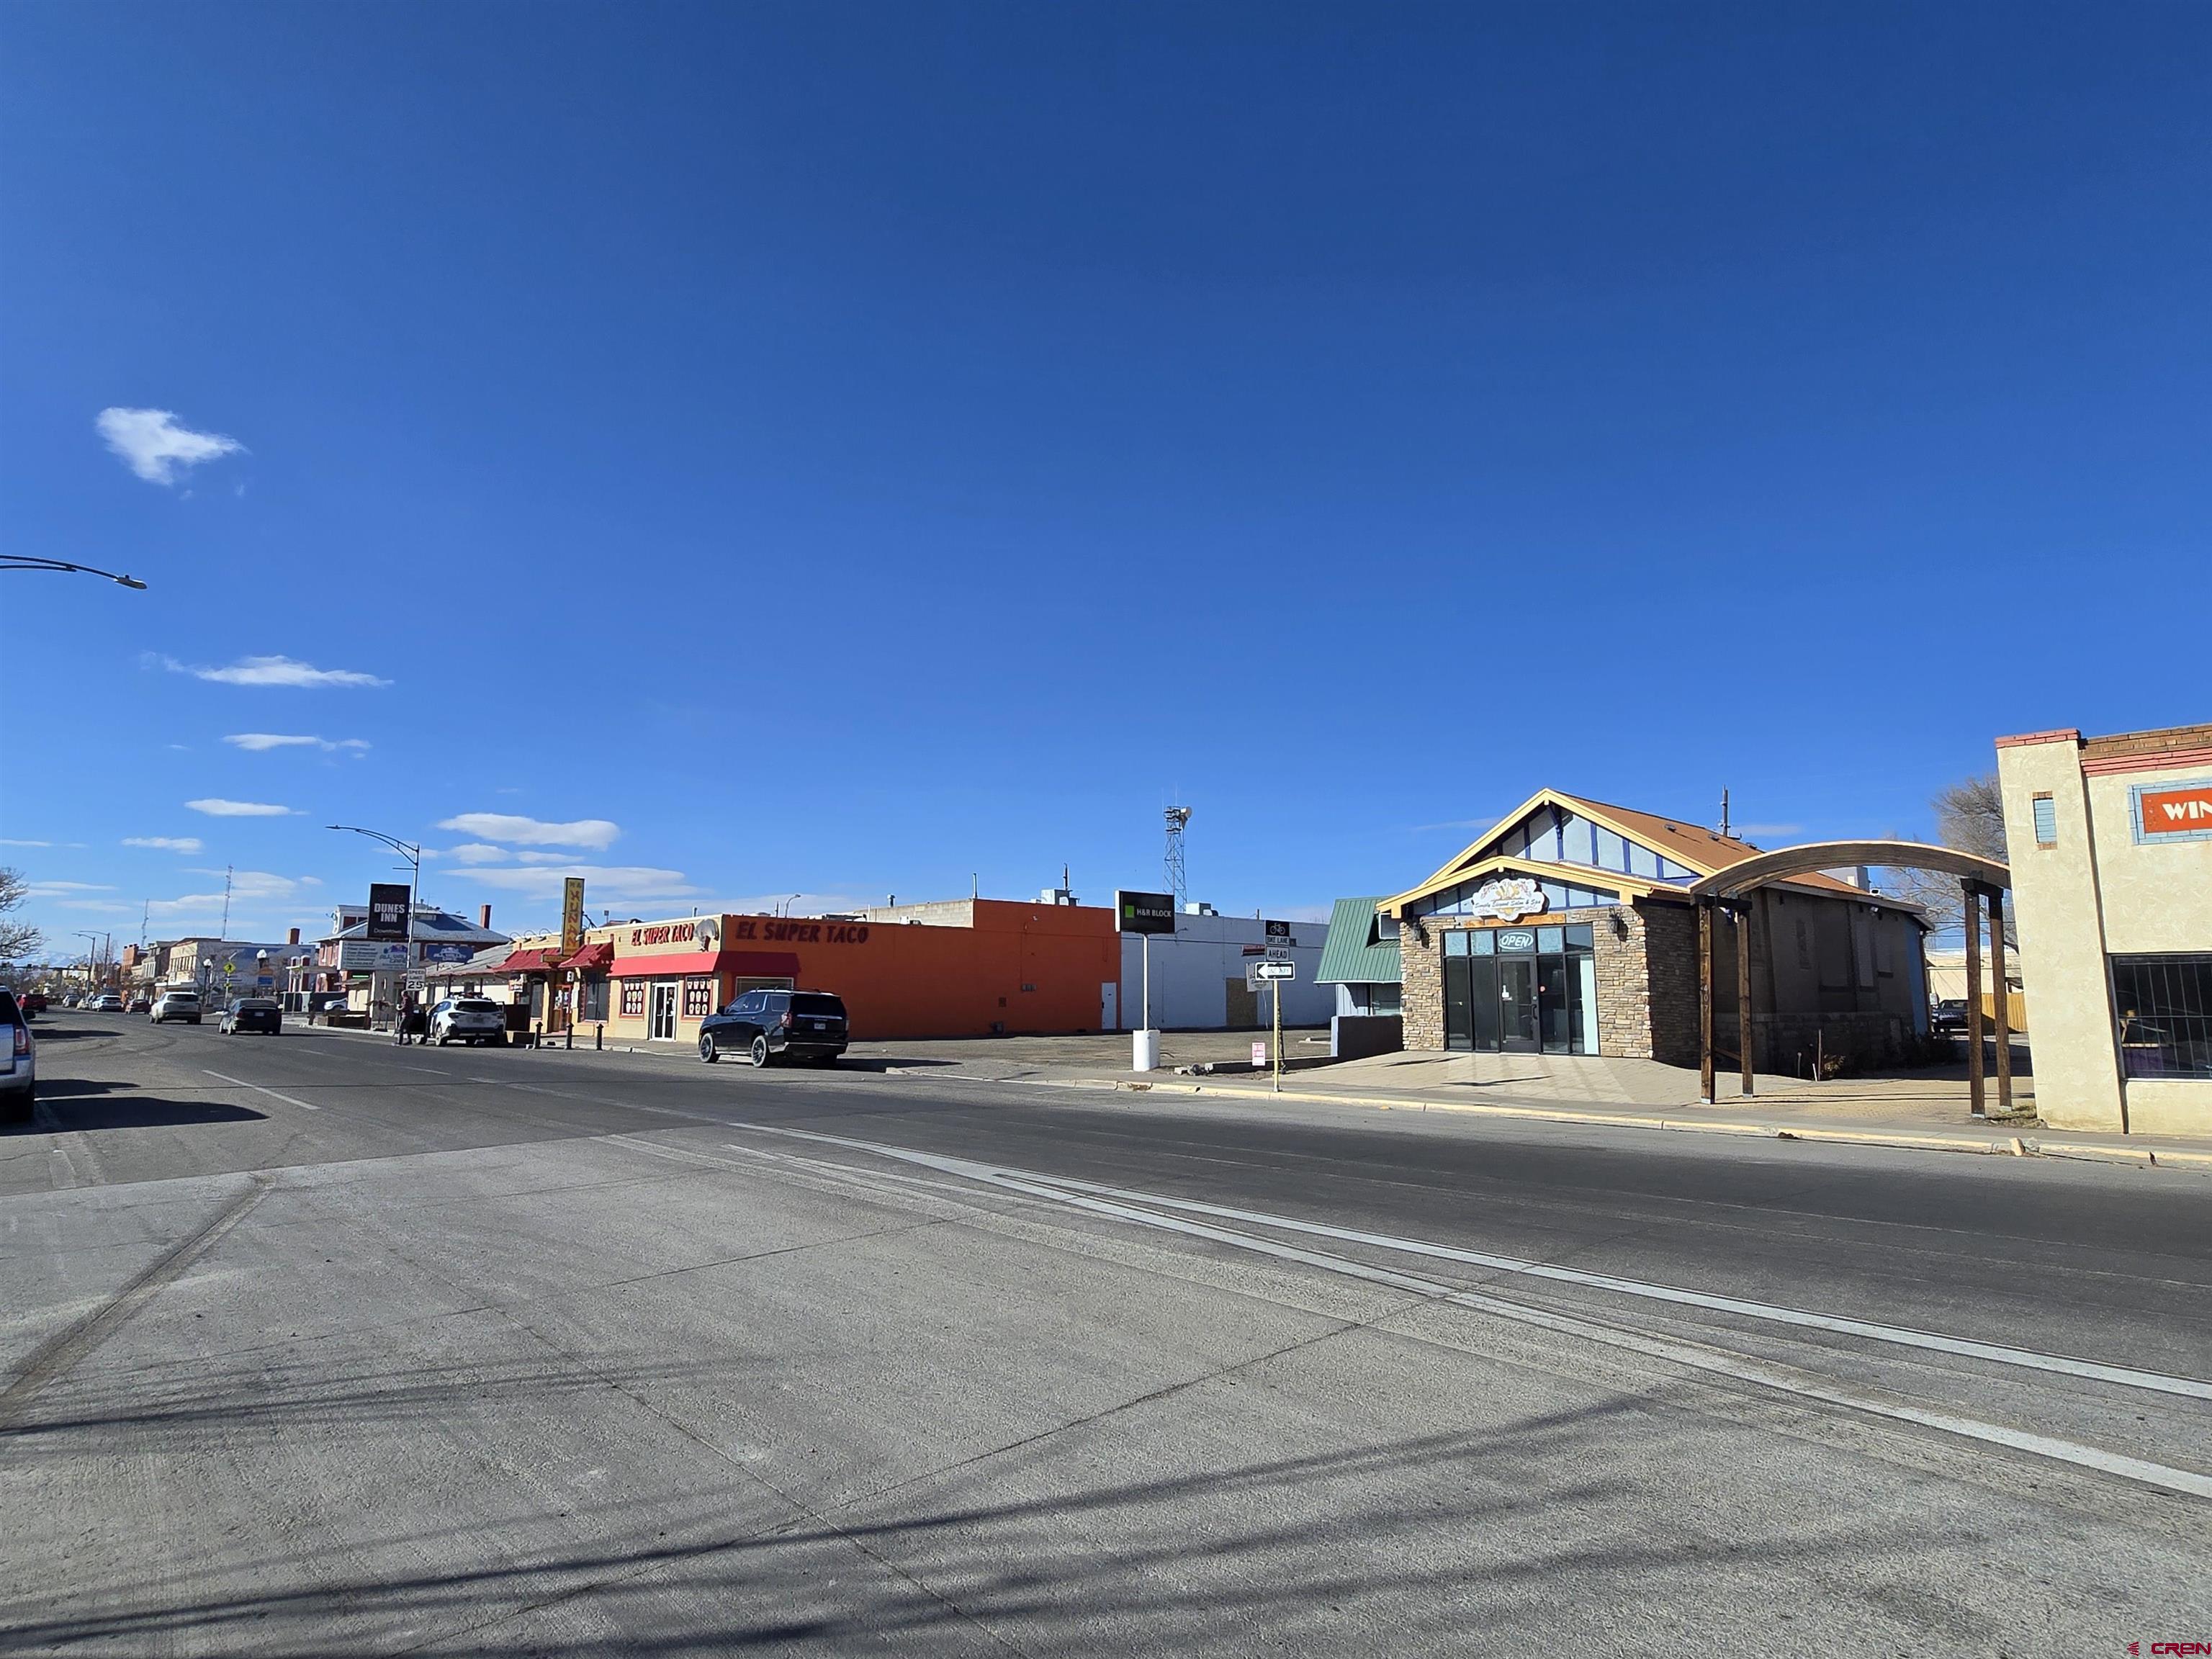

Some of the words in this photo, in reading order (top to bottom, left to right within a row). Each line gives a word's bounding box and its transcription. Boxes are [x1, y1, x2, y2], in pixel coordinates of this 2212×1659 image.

[374, 904, 405, 913] DUNES
[381, 914, 397, 922] INN
[567, 890, 580, 948] HUNAN
[631, 929, 642, 947] EL
[644, 926, 670, 945] SUPER
[672, 922, 696, 943] TACO
[737, 922, 757, 940] EL
[764, 922, 822, 943] SUPER
[827, 925, 869, 944] TACO
[1501, 935, 1530, 948] OPEN
[1268, 949, 1287, 959] AHEAD
[408, 981, 424, 989] 25
